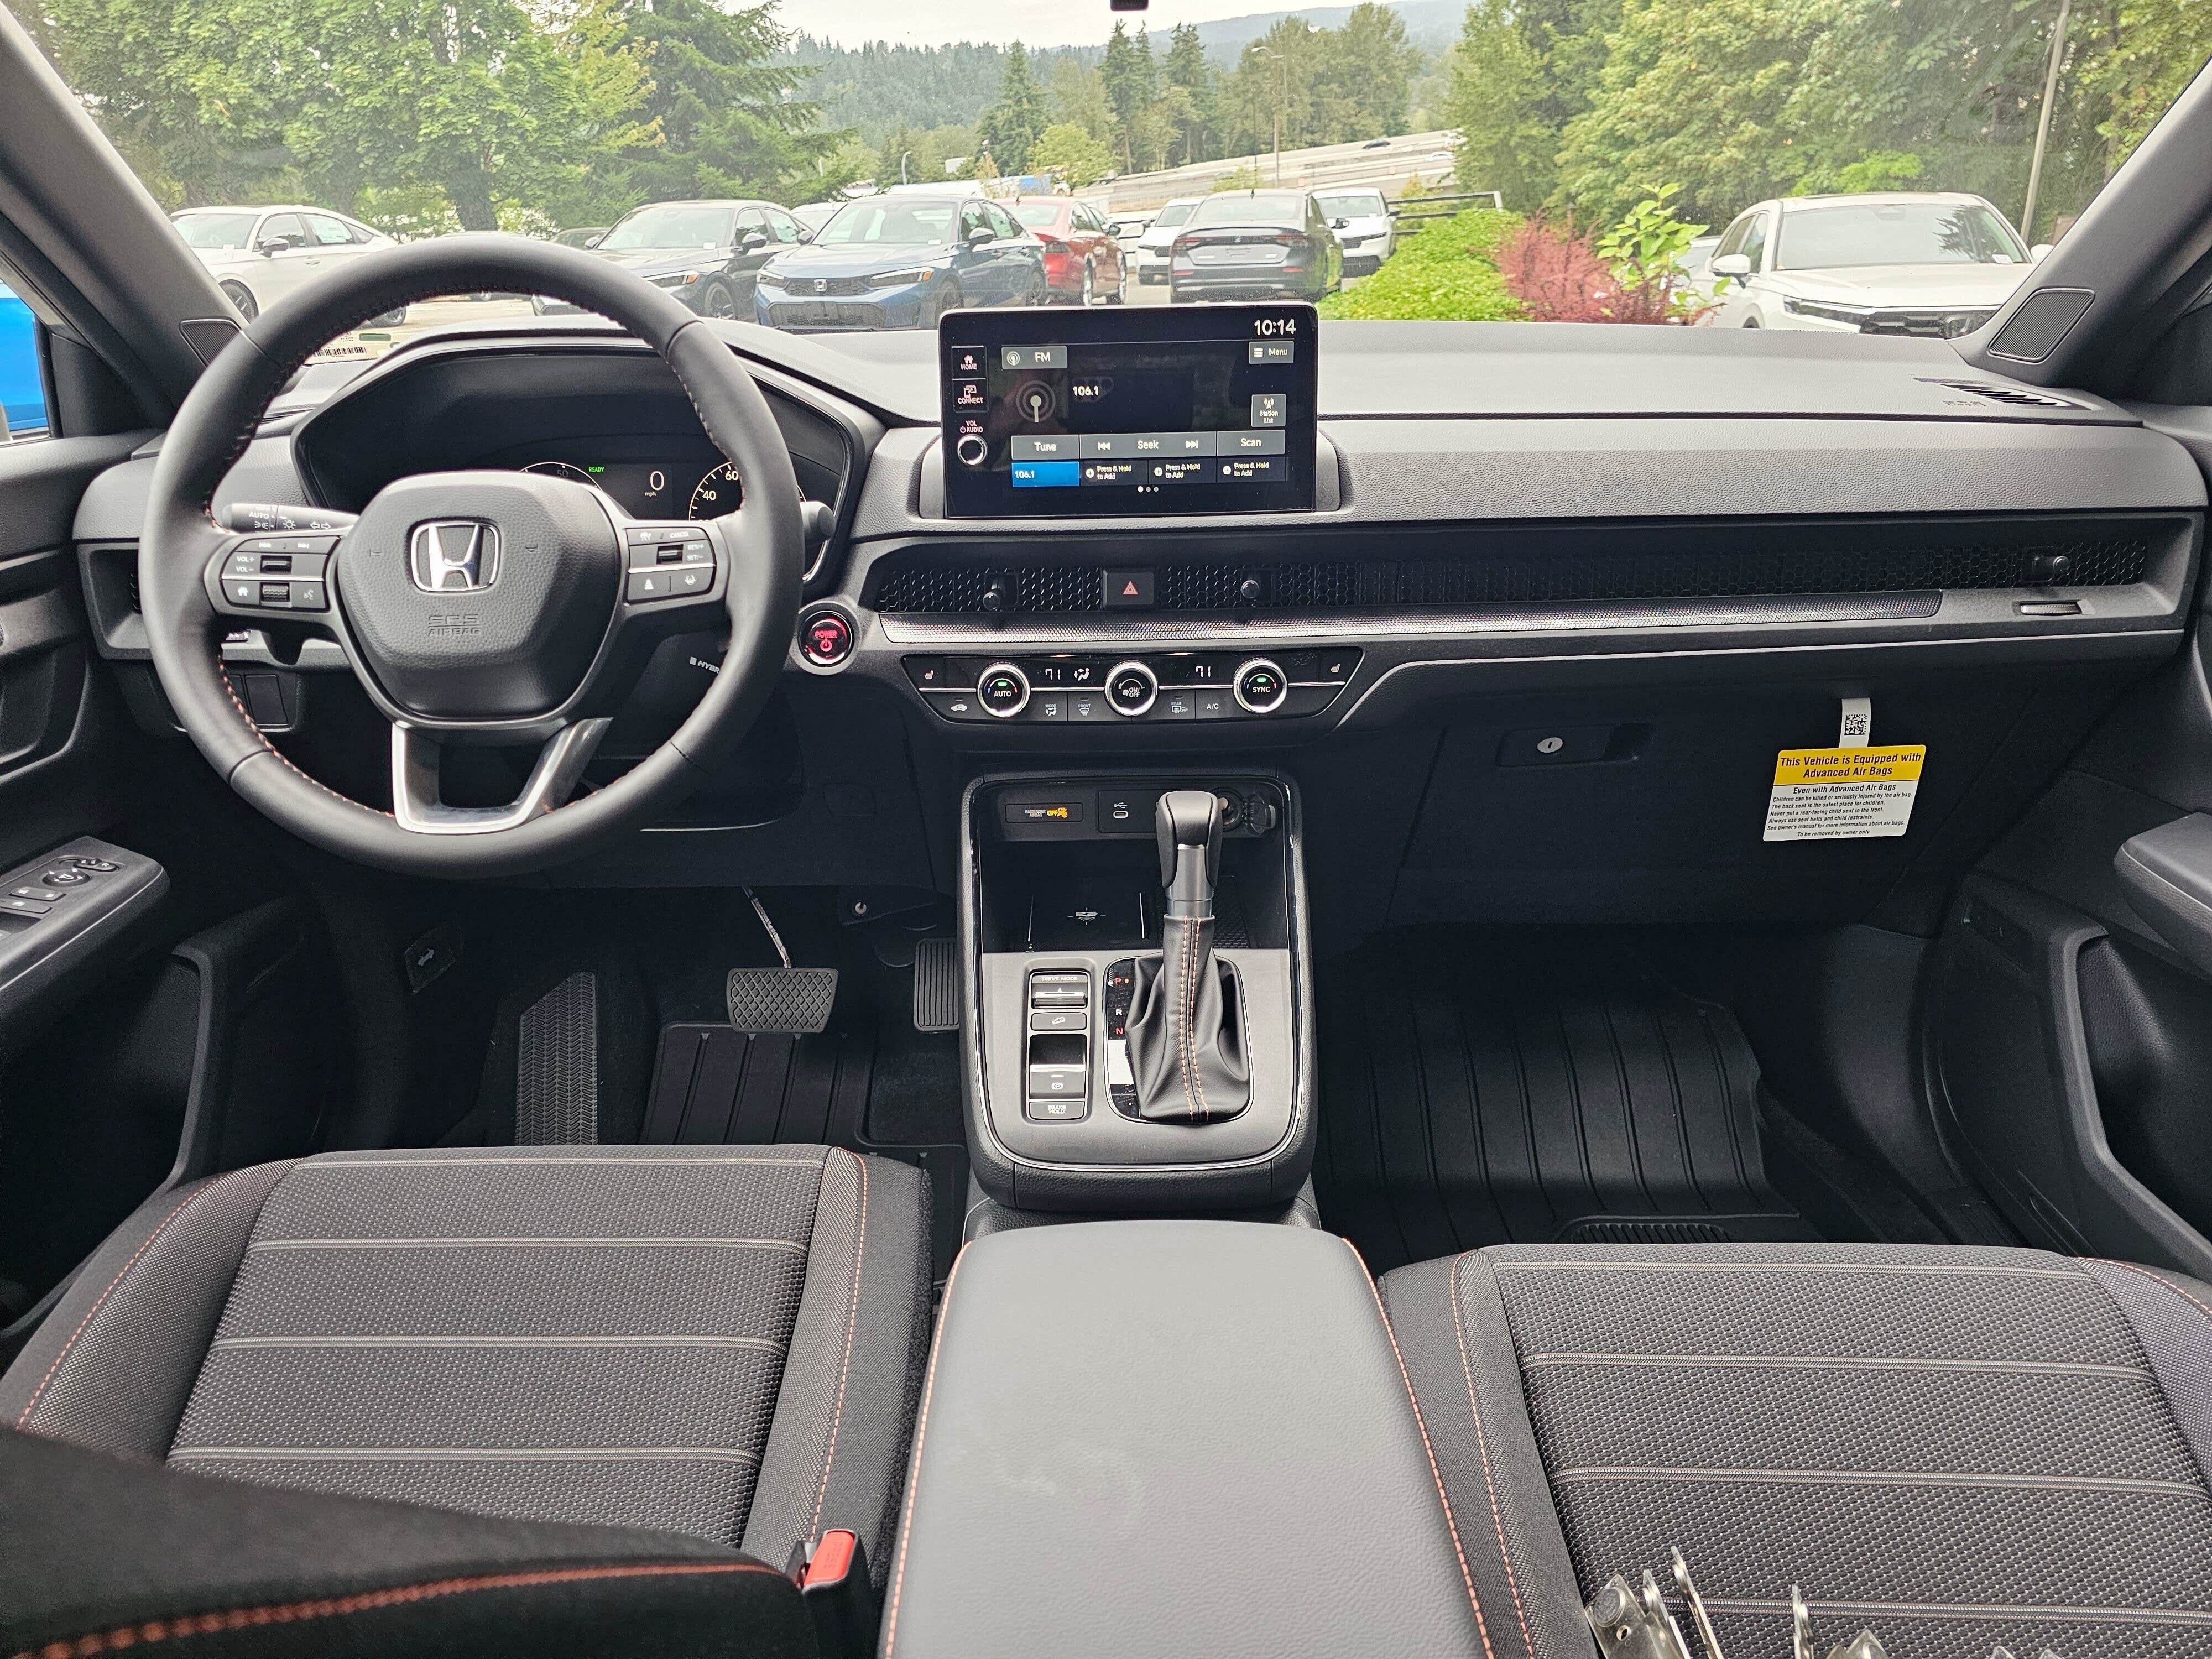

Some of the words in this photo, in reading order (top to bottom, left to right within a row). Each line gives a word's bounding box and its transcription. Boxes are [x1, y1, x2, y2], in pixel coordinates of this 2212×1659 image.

[1254, 319, 1296, 335] 10:14
[1035, 352, 1051, 362] FM
[1269, 348, 1288, 356] Menu
[1072, 385, 1099, 396] 106.1
[1034, 442, 1057, 452] Tune
[1138, 440, 1159, 450] Seek
[1241, 438, 1261, 447] Scan
[557, 469, 568, 478] 50
[725, 471, 738, 481] 60
[1015, 471, 1035, 479] 106.1
[650, 471, 665, 491] 0
[702, 490, 717, 501] 40
[428, 614, 479, 624] SRS
[428, 628, 480, 636] AIRBAG
[815, 630, 838, 638] POWER
[697, 660, 720, 674] HYBR
[1196, 665, 1211, 677] 71
[1045, 668, 1061, 680] 71
[1781, 757, 1801, 766] This
[1804, 755, 1839, 766] Vehicle
[1842, 755, 1851, 764] is
[1854, 753, 1898, 765] Equipped
[1901, 753, 1921, 761] with
[1803, 768, 1850, 778] Advanced
[1852, 767, 1867, 776] Air
[1869, 766, 1893, 776] Bags
[1829, 784, 1865, 792] Advanced
